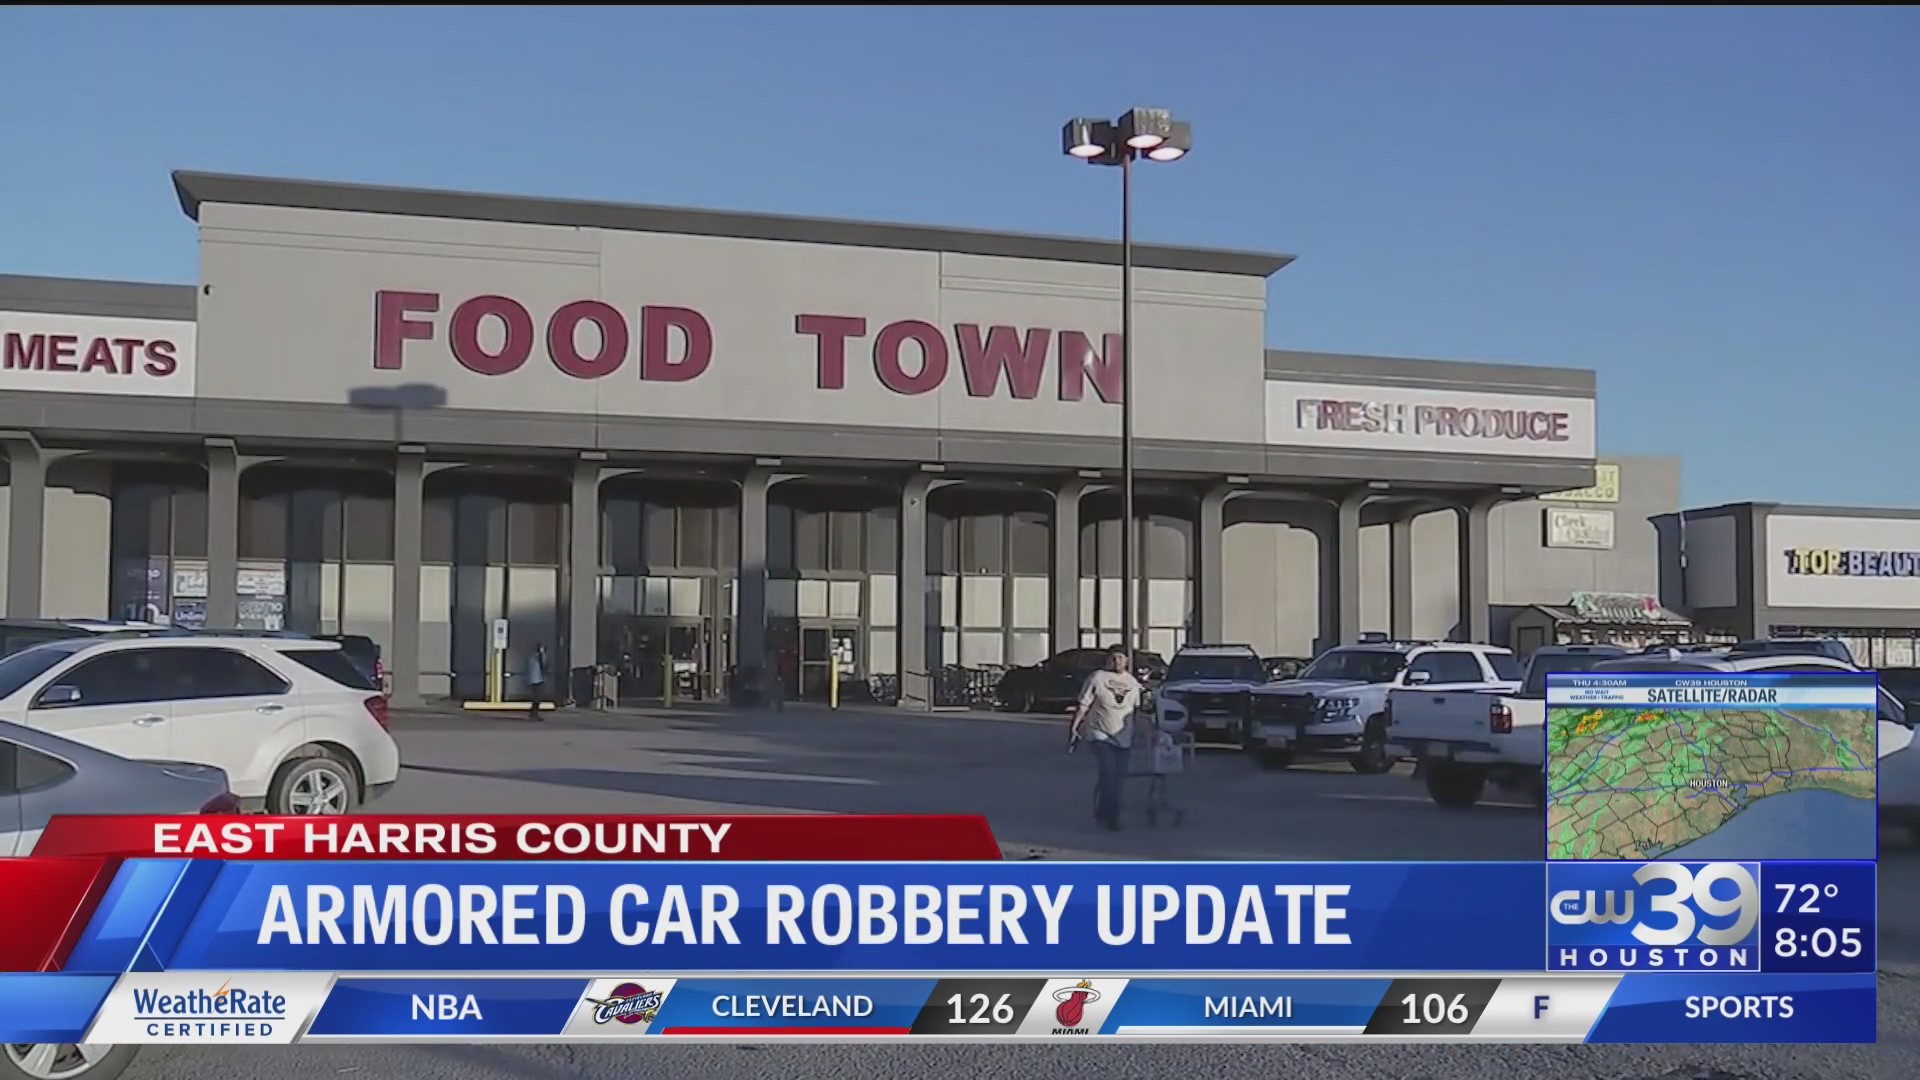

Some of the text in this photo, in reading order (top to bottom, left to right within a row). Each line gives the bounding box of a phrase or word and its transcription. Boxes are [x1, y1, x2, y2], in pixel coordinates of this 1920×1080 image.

[3, 333, 177, 377] MEATS
[374, 290, 1123, 404] FOOD TOWN
[1297, 399, 1569, 441] FRESH PRODUCE
